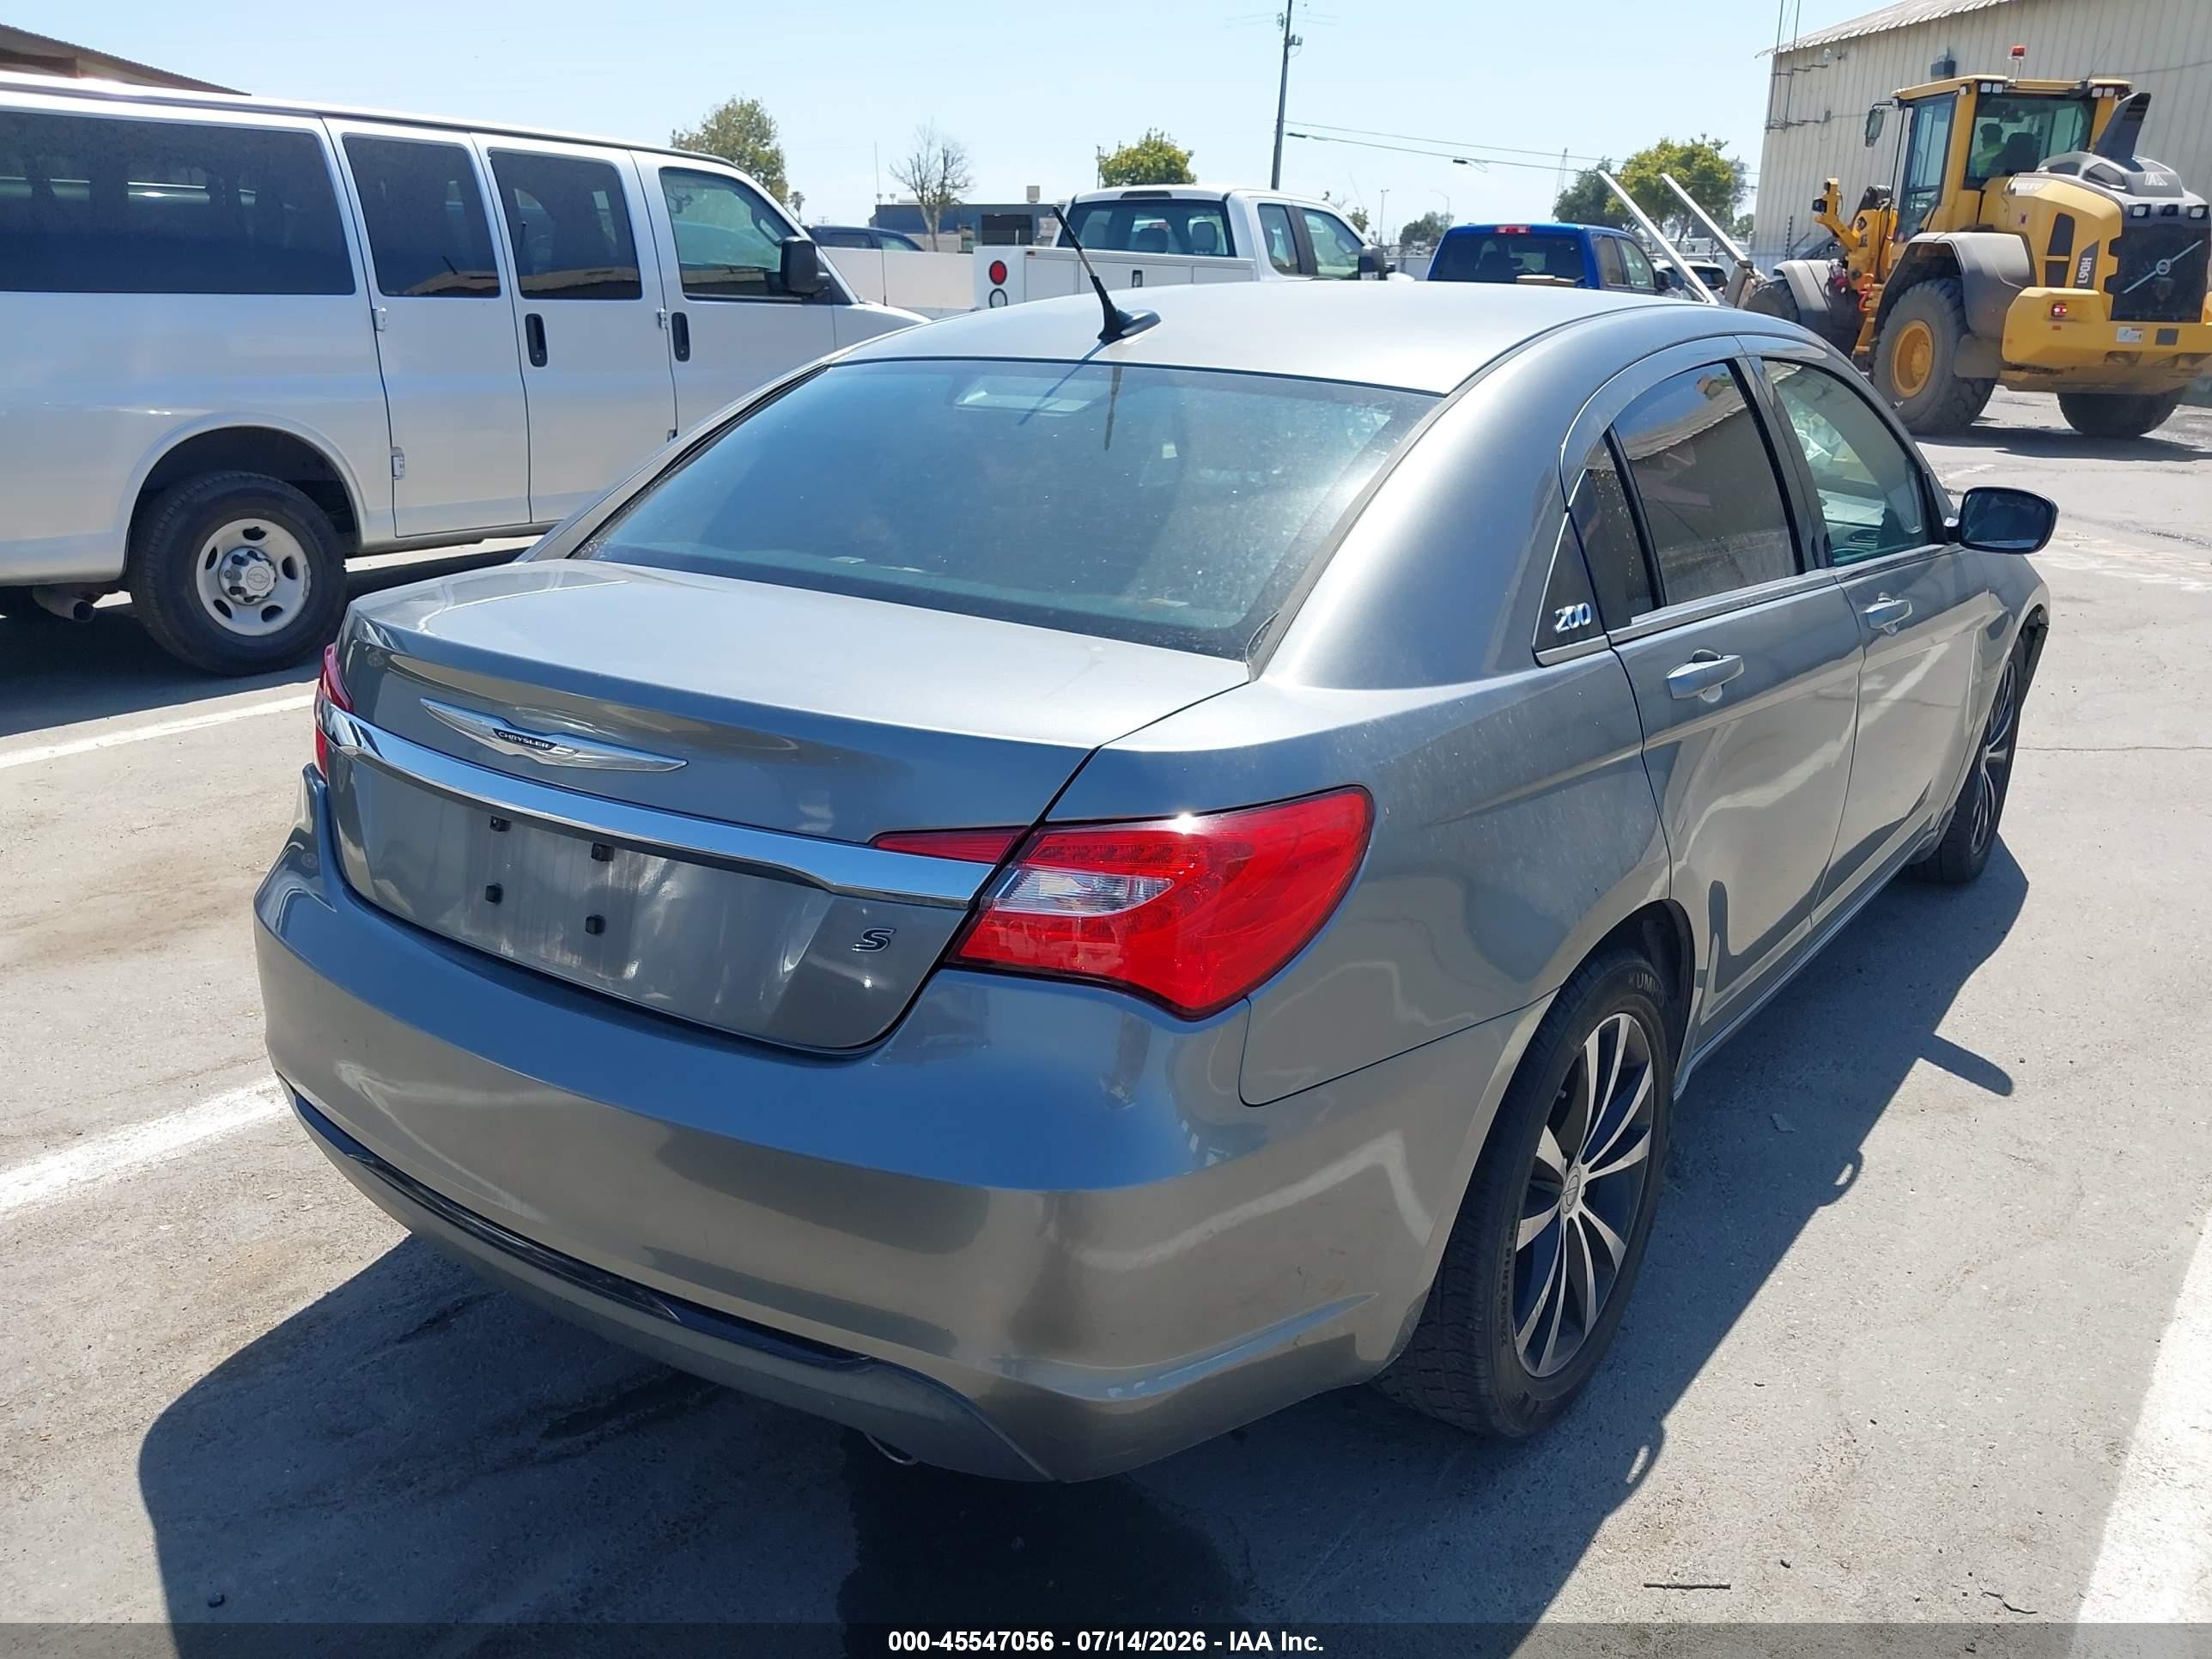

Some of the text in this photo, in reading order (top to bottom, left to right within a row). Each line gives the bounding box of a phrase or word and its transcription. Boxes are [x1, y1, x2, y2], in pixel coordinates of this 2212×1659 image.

[2076, 257, 2094, 284] L90H
[1554, 602, 1592, 634] 200
[498, 732, 552, 749] CHRYSLER
[852, 927, 896, 952] S
